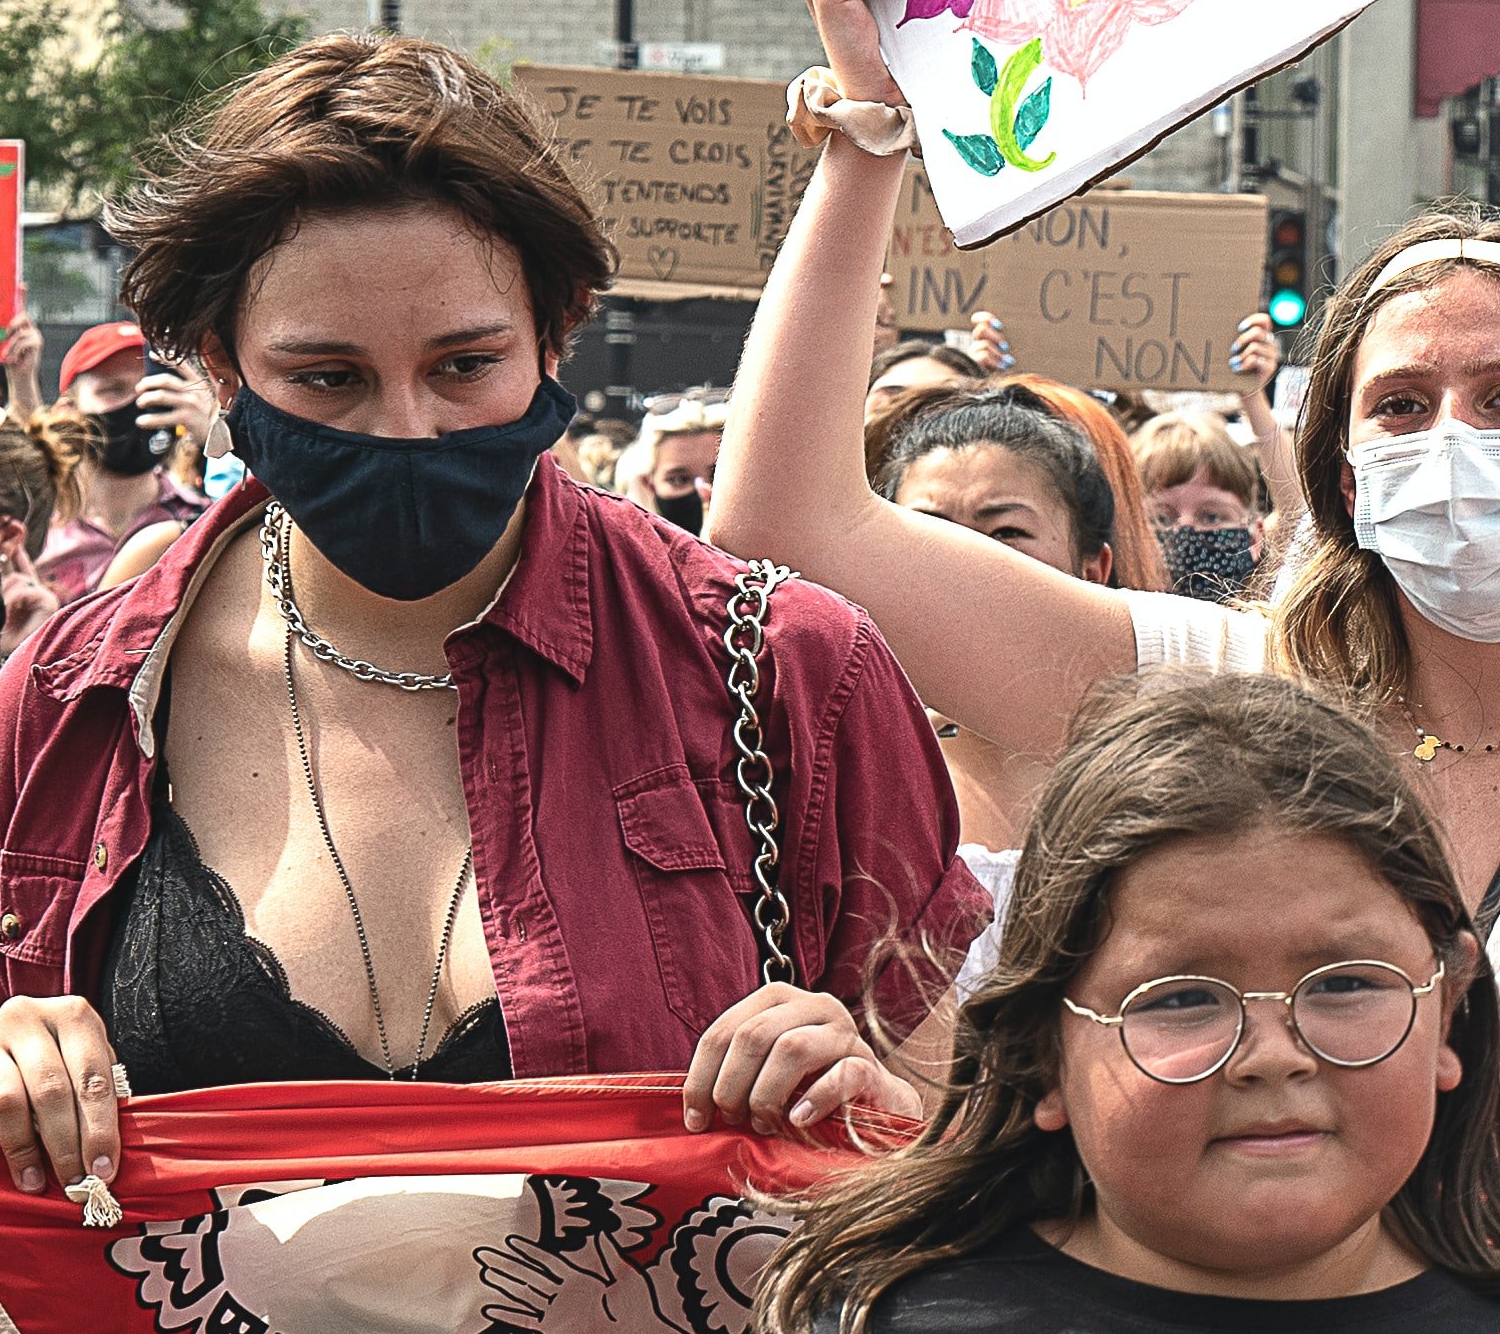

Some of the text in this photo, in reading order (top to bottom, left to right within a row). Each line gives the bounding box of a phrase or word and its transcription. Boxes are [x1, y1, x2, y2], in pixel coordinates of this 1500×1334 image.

[545, 85, 735, 126] JE TE VOIS
[609, 139, 654, 165] TE
[668, 138, 752, 169] CROIS
[1038, 267, 1192, 338] C'EST
[1093, 335, 1213, 384] NON
